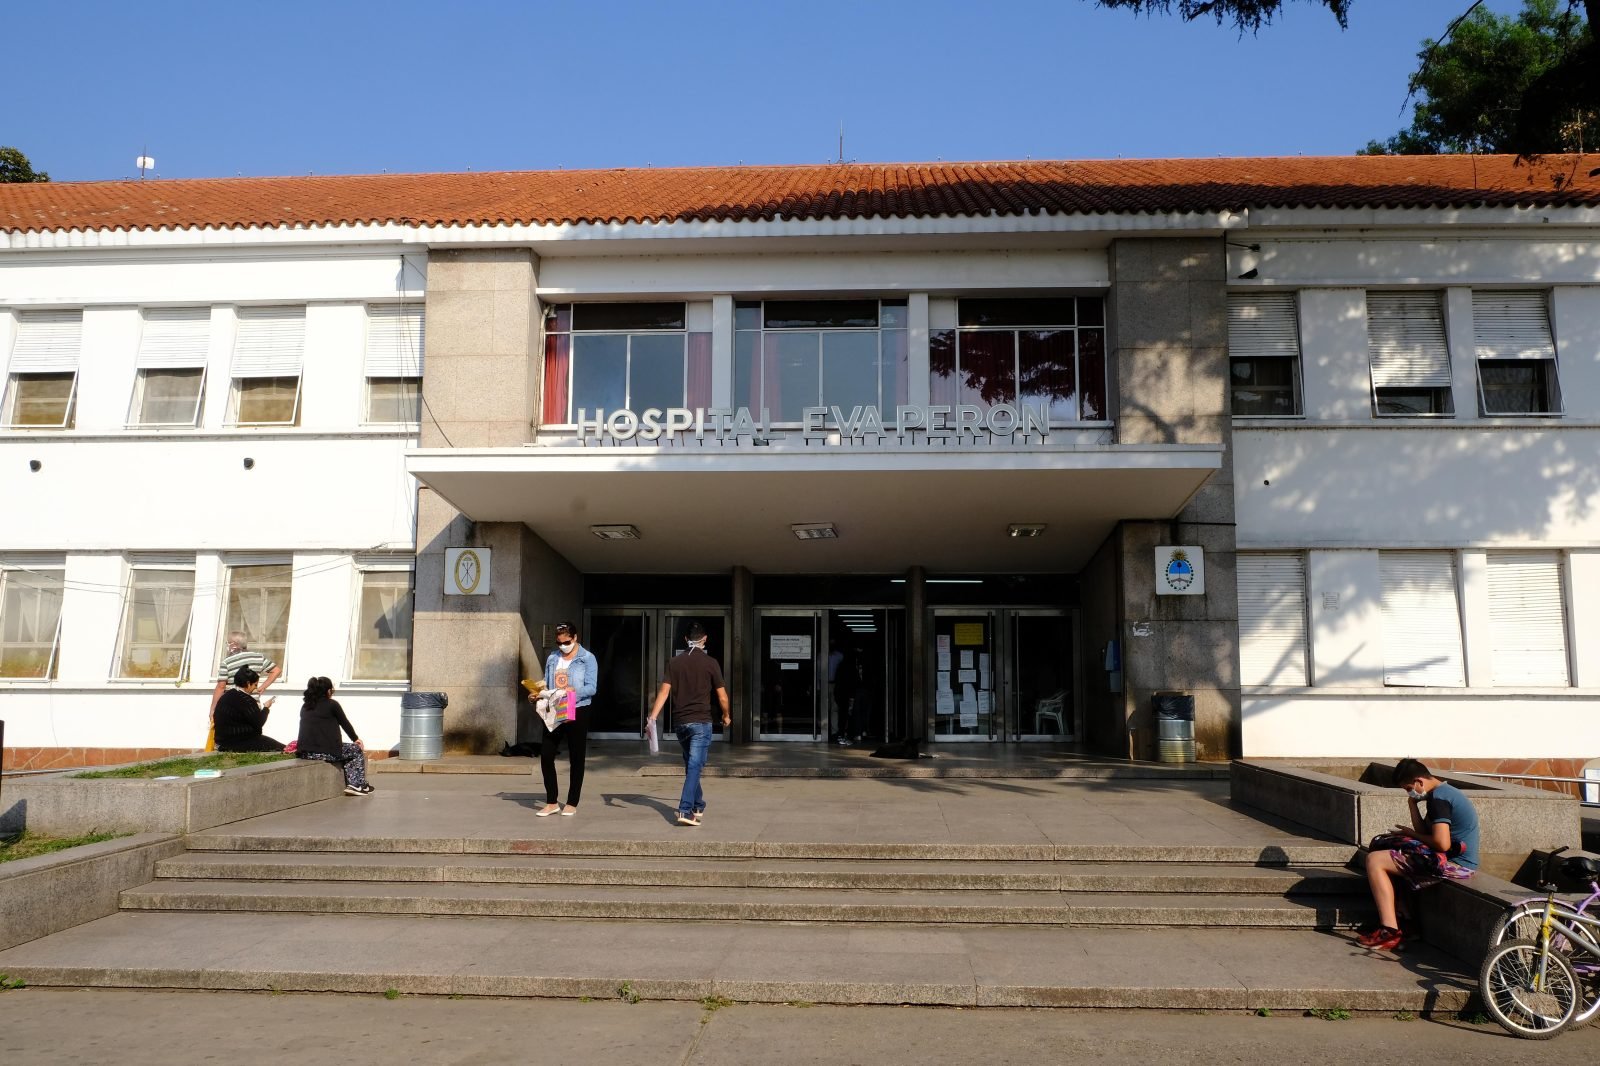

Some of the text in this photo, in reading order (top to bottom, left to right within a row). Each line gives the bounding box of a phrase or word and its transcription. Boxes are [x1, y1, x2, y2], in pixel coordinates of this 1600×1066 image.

[577, 404, 1050, 440] HOSPITAL EVA PERON
